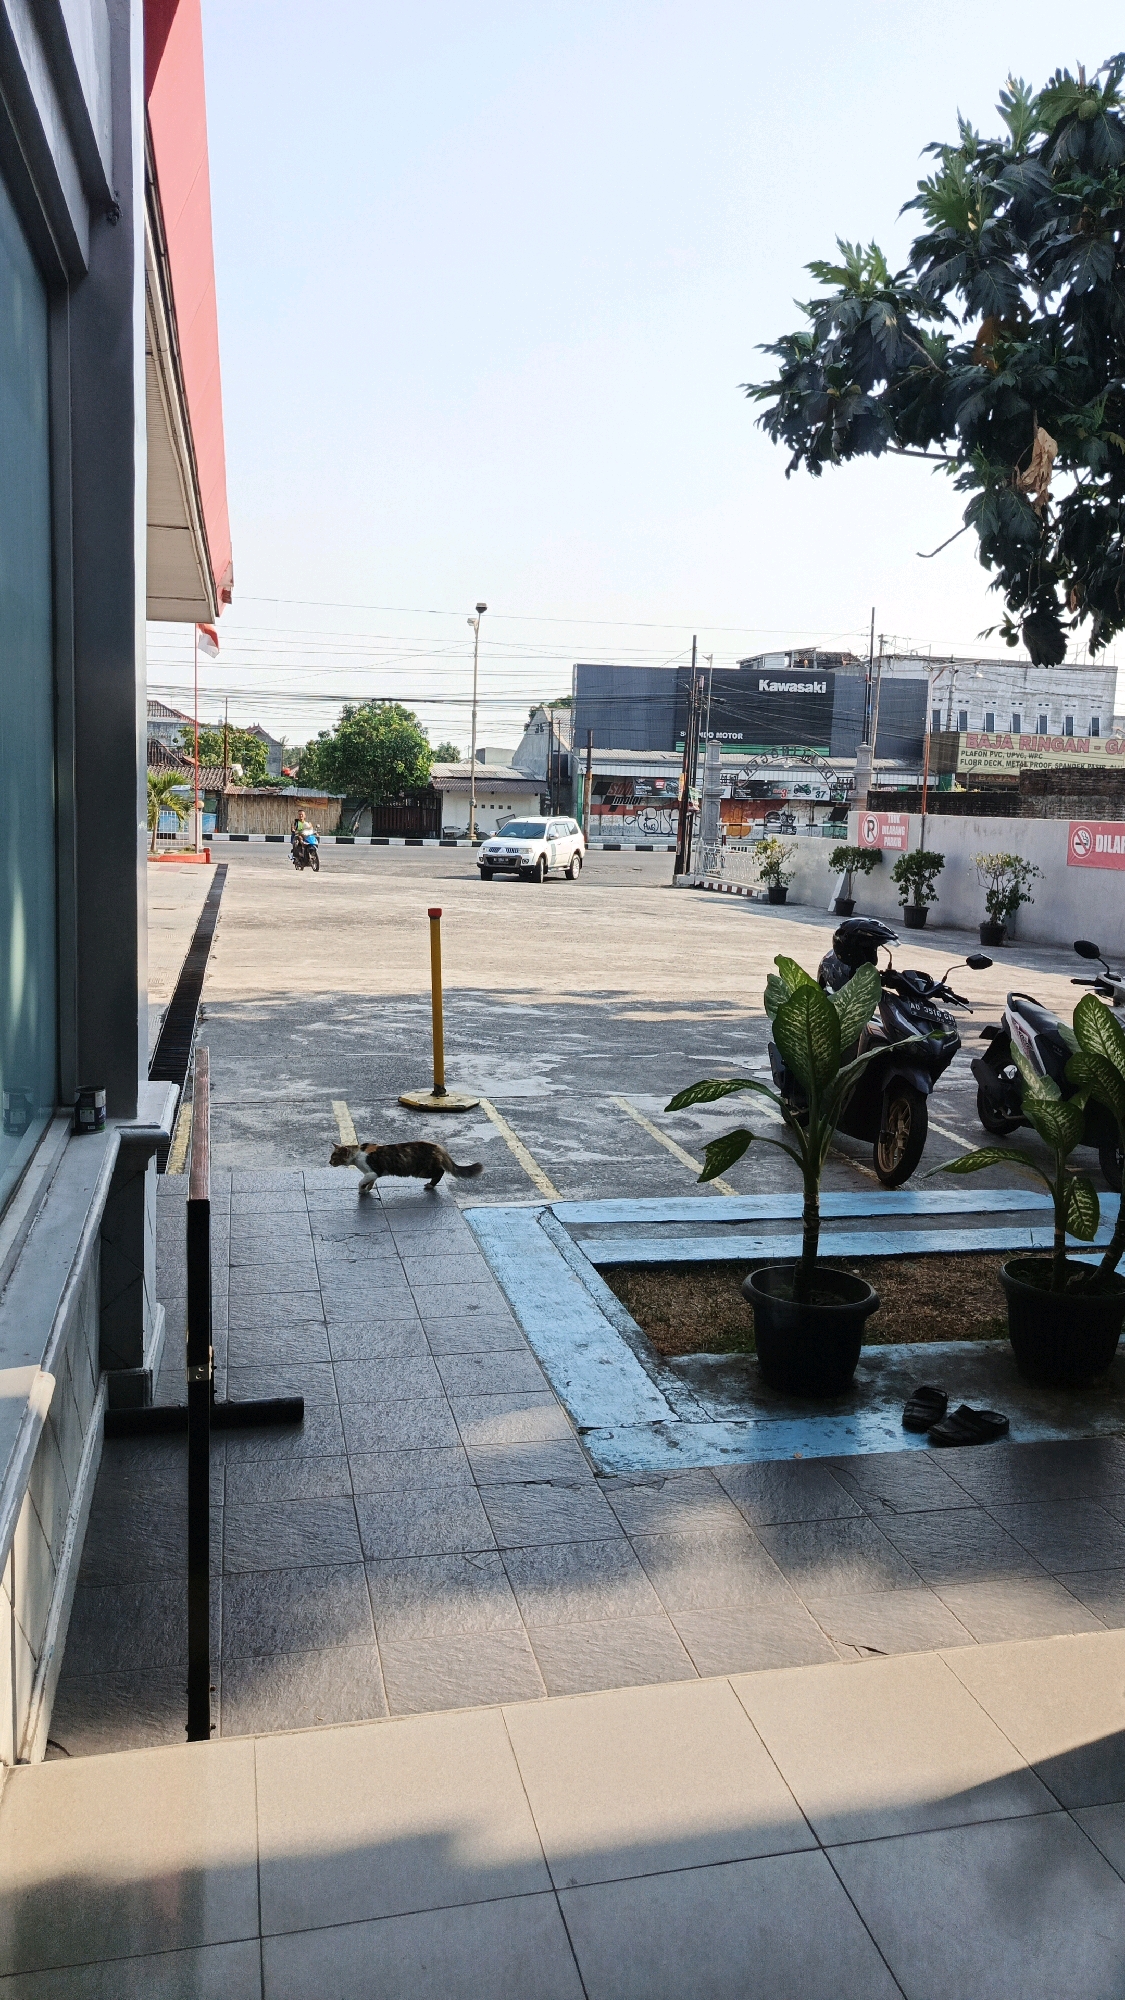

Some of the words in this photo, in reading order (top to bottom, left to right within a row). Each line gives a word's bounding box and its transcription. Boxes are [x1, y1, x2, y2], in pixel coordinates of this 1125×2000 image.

[759, 679, 826, 693] Kawasaki
[966, 733, 1014, 749] BAJA
[1018, 736, 1090, 753] RINGAN
[815, 790, 827, 799] 37
[881, 825, 906, 836] DILARANG
[883, 836, 902, 847] PARKIR
